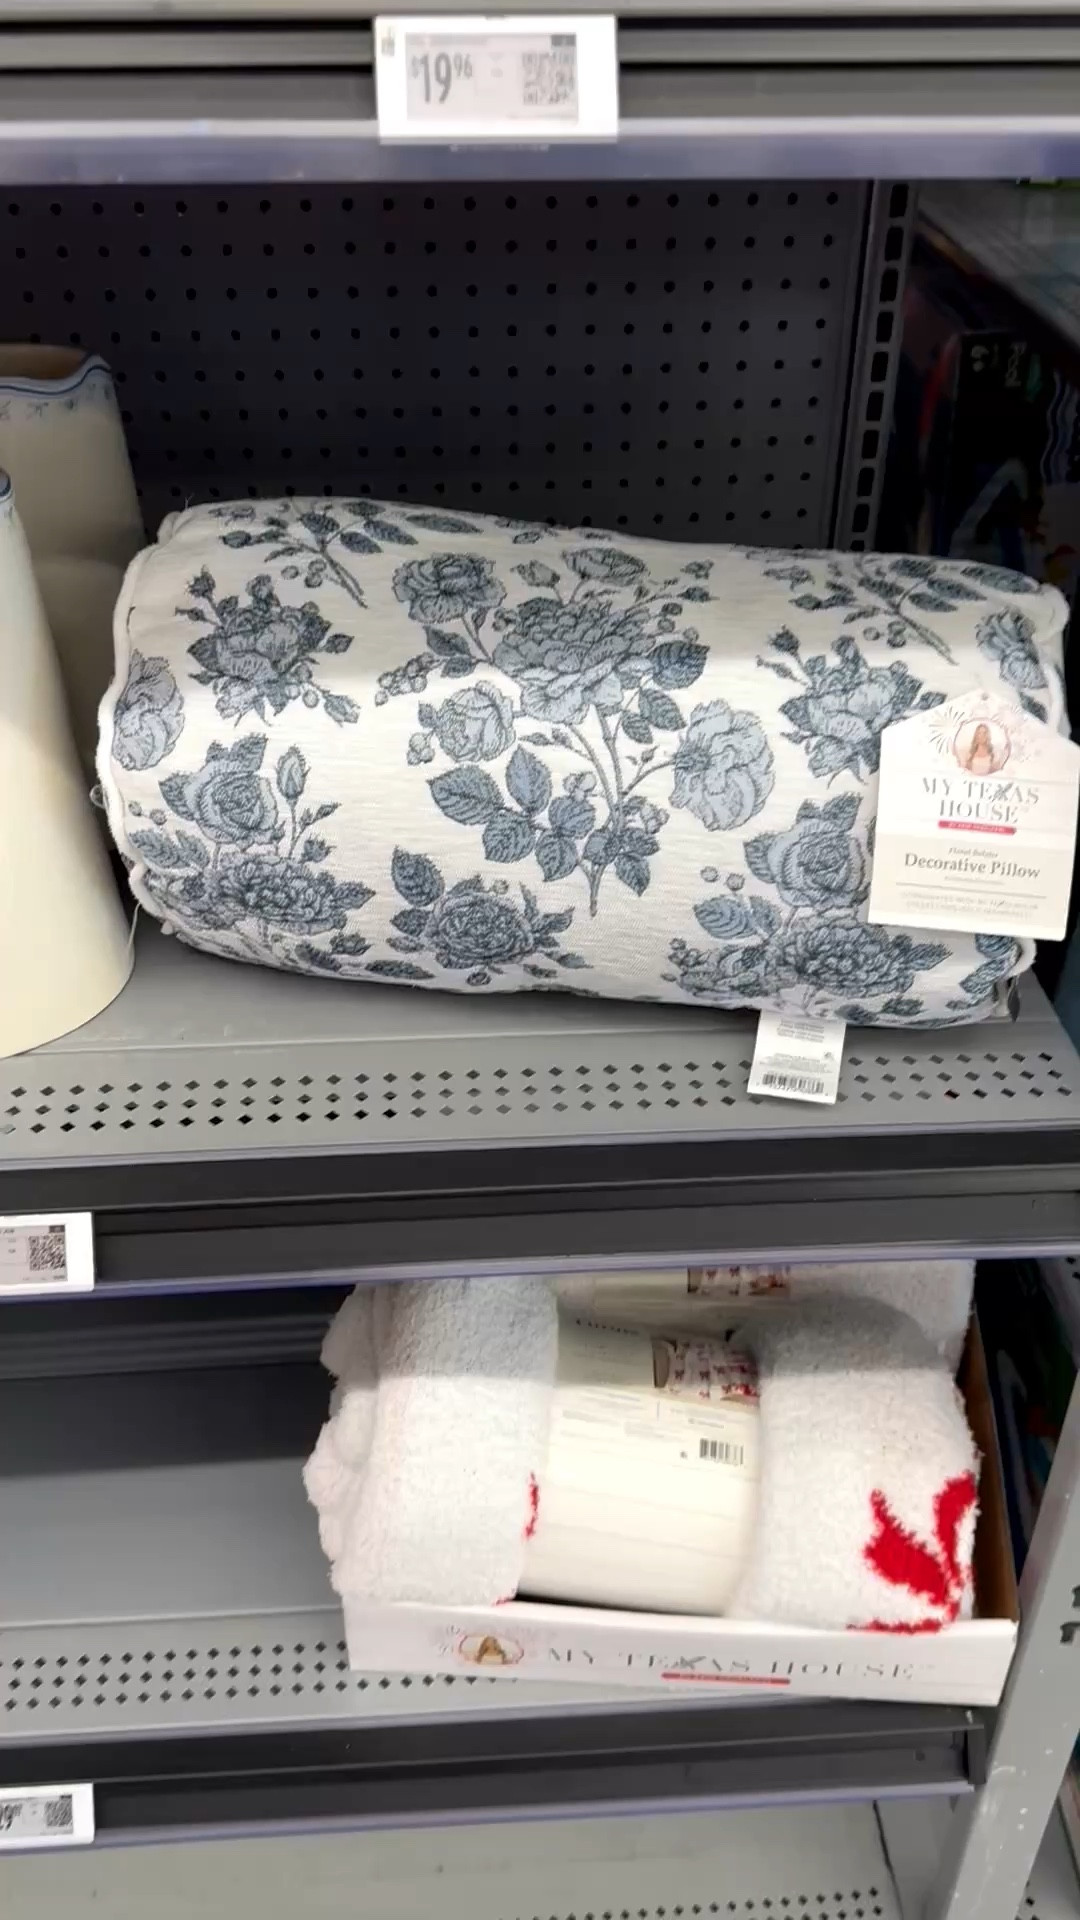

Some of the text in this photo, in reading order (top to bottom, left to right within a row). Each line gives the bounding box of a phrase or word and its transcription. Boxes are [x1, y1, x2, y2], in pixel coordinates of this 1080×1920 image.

[922, 777, 1040, 804] MY TEXAS
[938, 799, 1018, 824] HOUSE
[904, 852, 1041, 879] Decorative Pillow
[548, 1647, 595, 1666] MY
[618, 1651, 750, 1673] TEXAS
[770, 1659, 914, 1680] HOUSE
